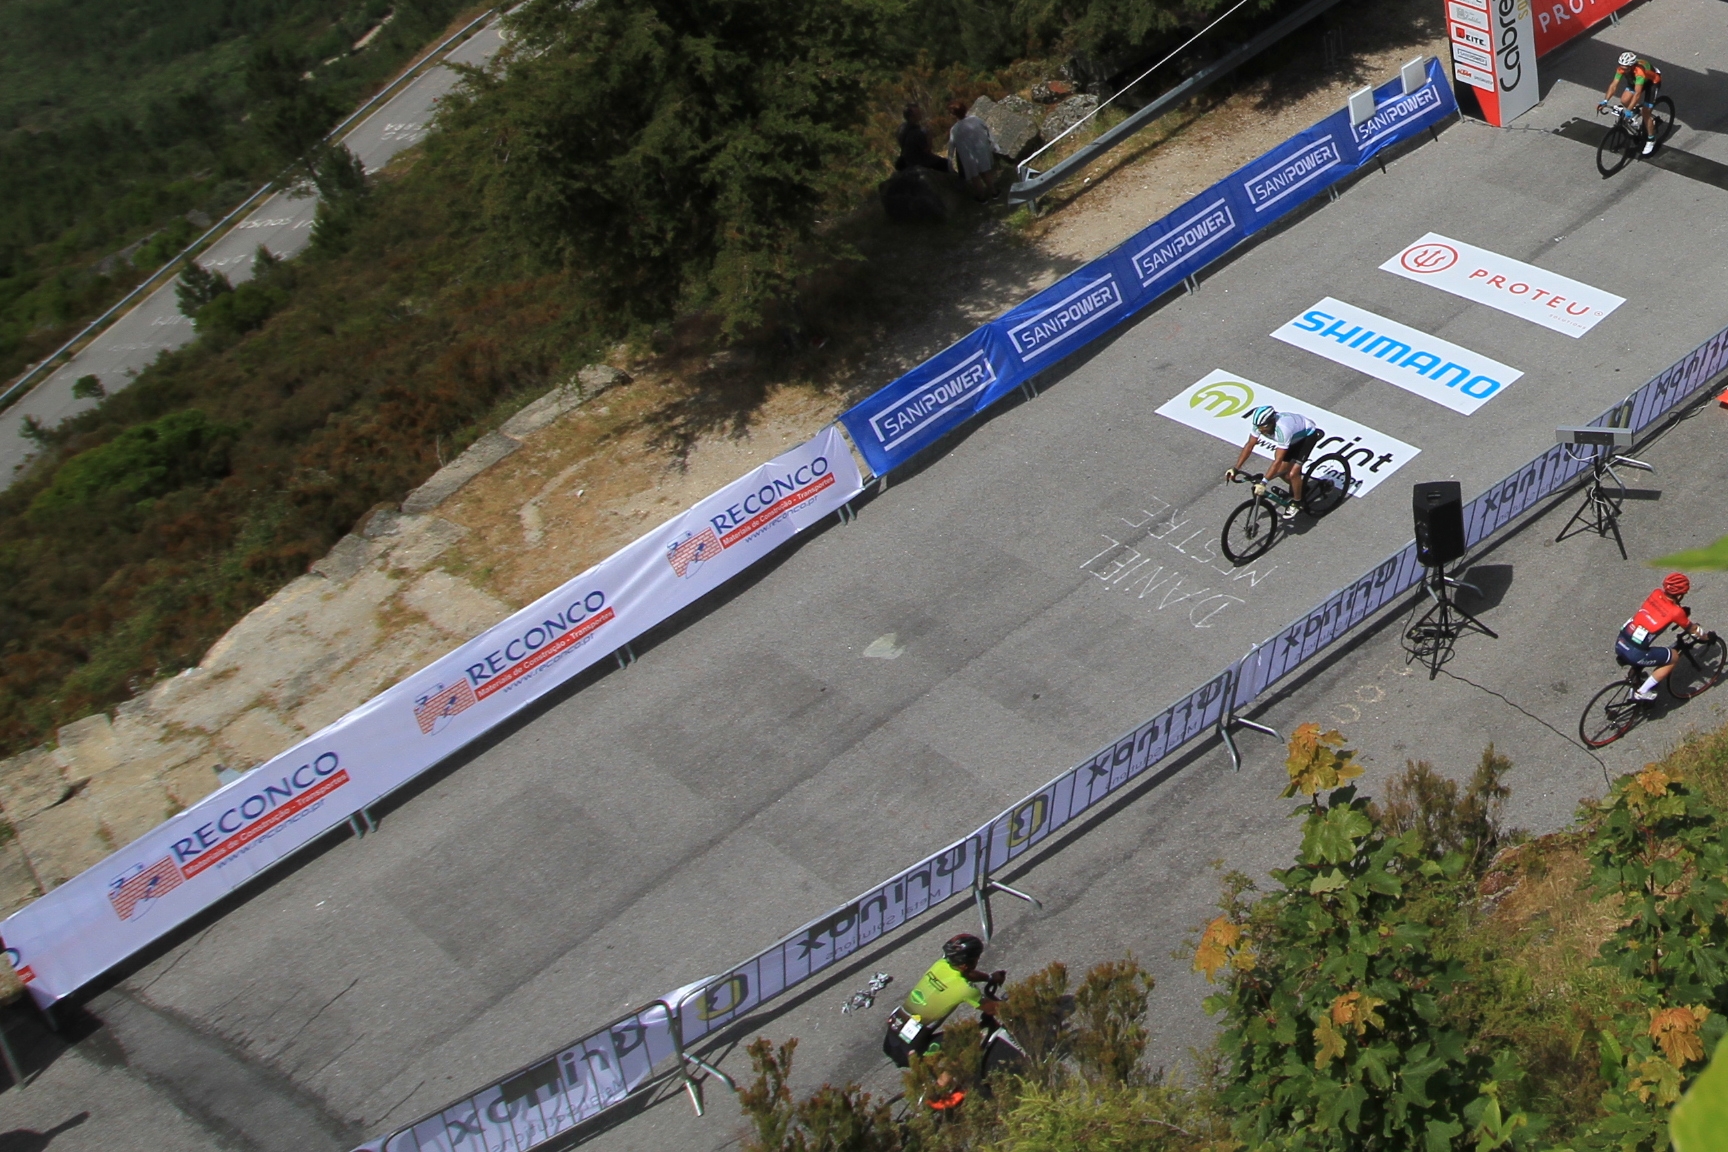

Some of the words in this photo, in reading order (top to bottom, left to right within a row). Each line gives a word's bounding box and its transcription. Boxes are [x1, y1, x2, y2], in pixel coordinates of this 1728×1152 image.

[1358, 88, 1434, 140] SANIPOWER
[1255, 140, 1334, 200] SANIPOWER
[1142, 209, 1227, 274] SANIPOWER
[1020, 284, 1114, 350] SANIPOWER
[1468, 268, 1590, 316] PROTEU
[1549, 313, 1587, 330] SOLUTIONS
[1292, 310, 1501, 400] SHIMANO
[882, 362, 985, 441] SANIPOWER
[709, 456, 828, 535] RECONCO
[722, 525, 752, 546] Materiais
[759, 499, 793, 524] Construção
[797, 475, 834, 500] Transportes
[1080, 534, 1245, 628] DANIEL
[465, 590, 606, 686] RECONCO
[477, 673, 513, 698] Materiais
[523, 638, 567, 670] Construção
[570, 610, 614, 640] Transportes
[170, 751, 339, 864] RECONCO
[239, 807, 291, 843] Construção
[296, 773, 348, 807] Transportes
